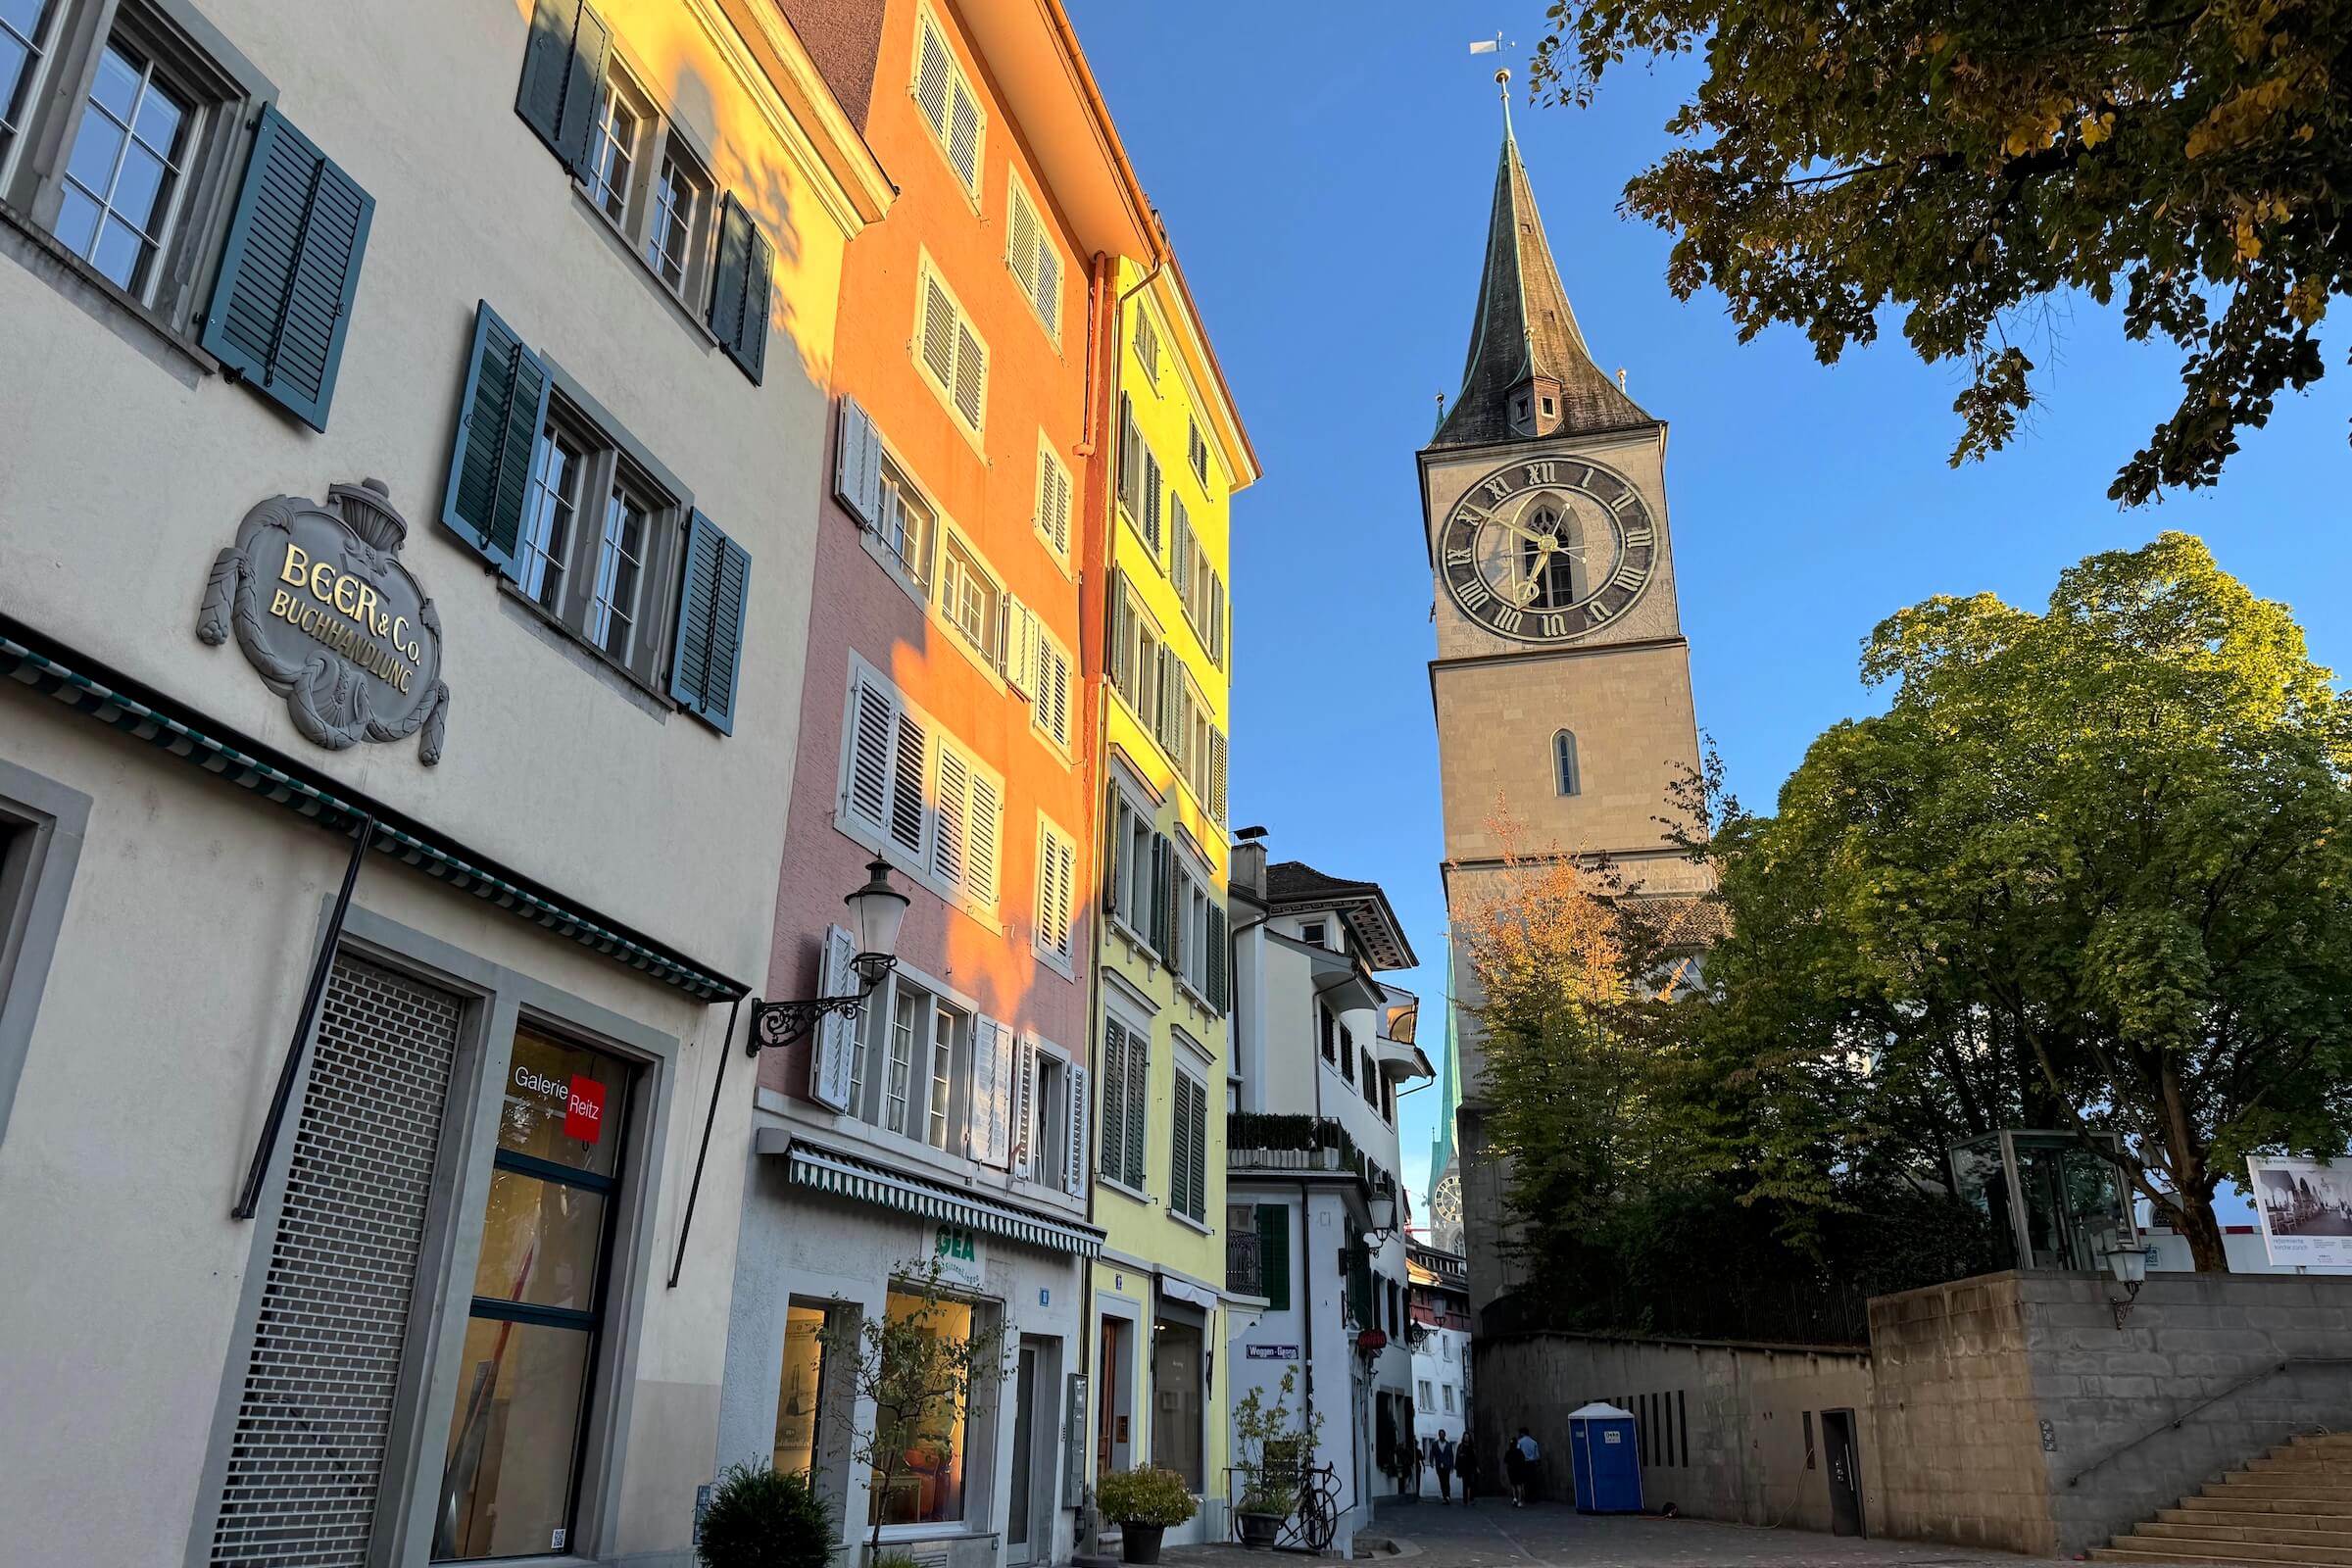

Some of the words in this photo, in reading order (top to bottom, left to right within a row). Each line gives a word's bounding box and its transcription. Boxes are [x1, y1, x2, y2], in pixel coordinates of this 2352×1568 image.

[1527, 462, 1556, 485] XII
[1582, 466, 1594, 488] I
[1484, 476, 1512, 501] XI
[1456, 510, 1483, 526] X
[1626, 527, 1653, 549] III
[1446, 547, 1472, 567] IX
[279, 543, 377, 637] BEER
[269, 588, 413, 695] BUCHHANDLUNG
[514, 1066, 568, 1101] Galerie
[569, 1094, 600, 1120] Reitz
[936, 1224, 975, 1263] GEA
